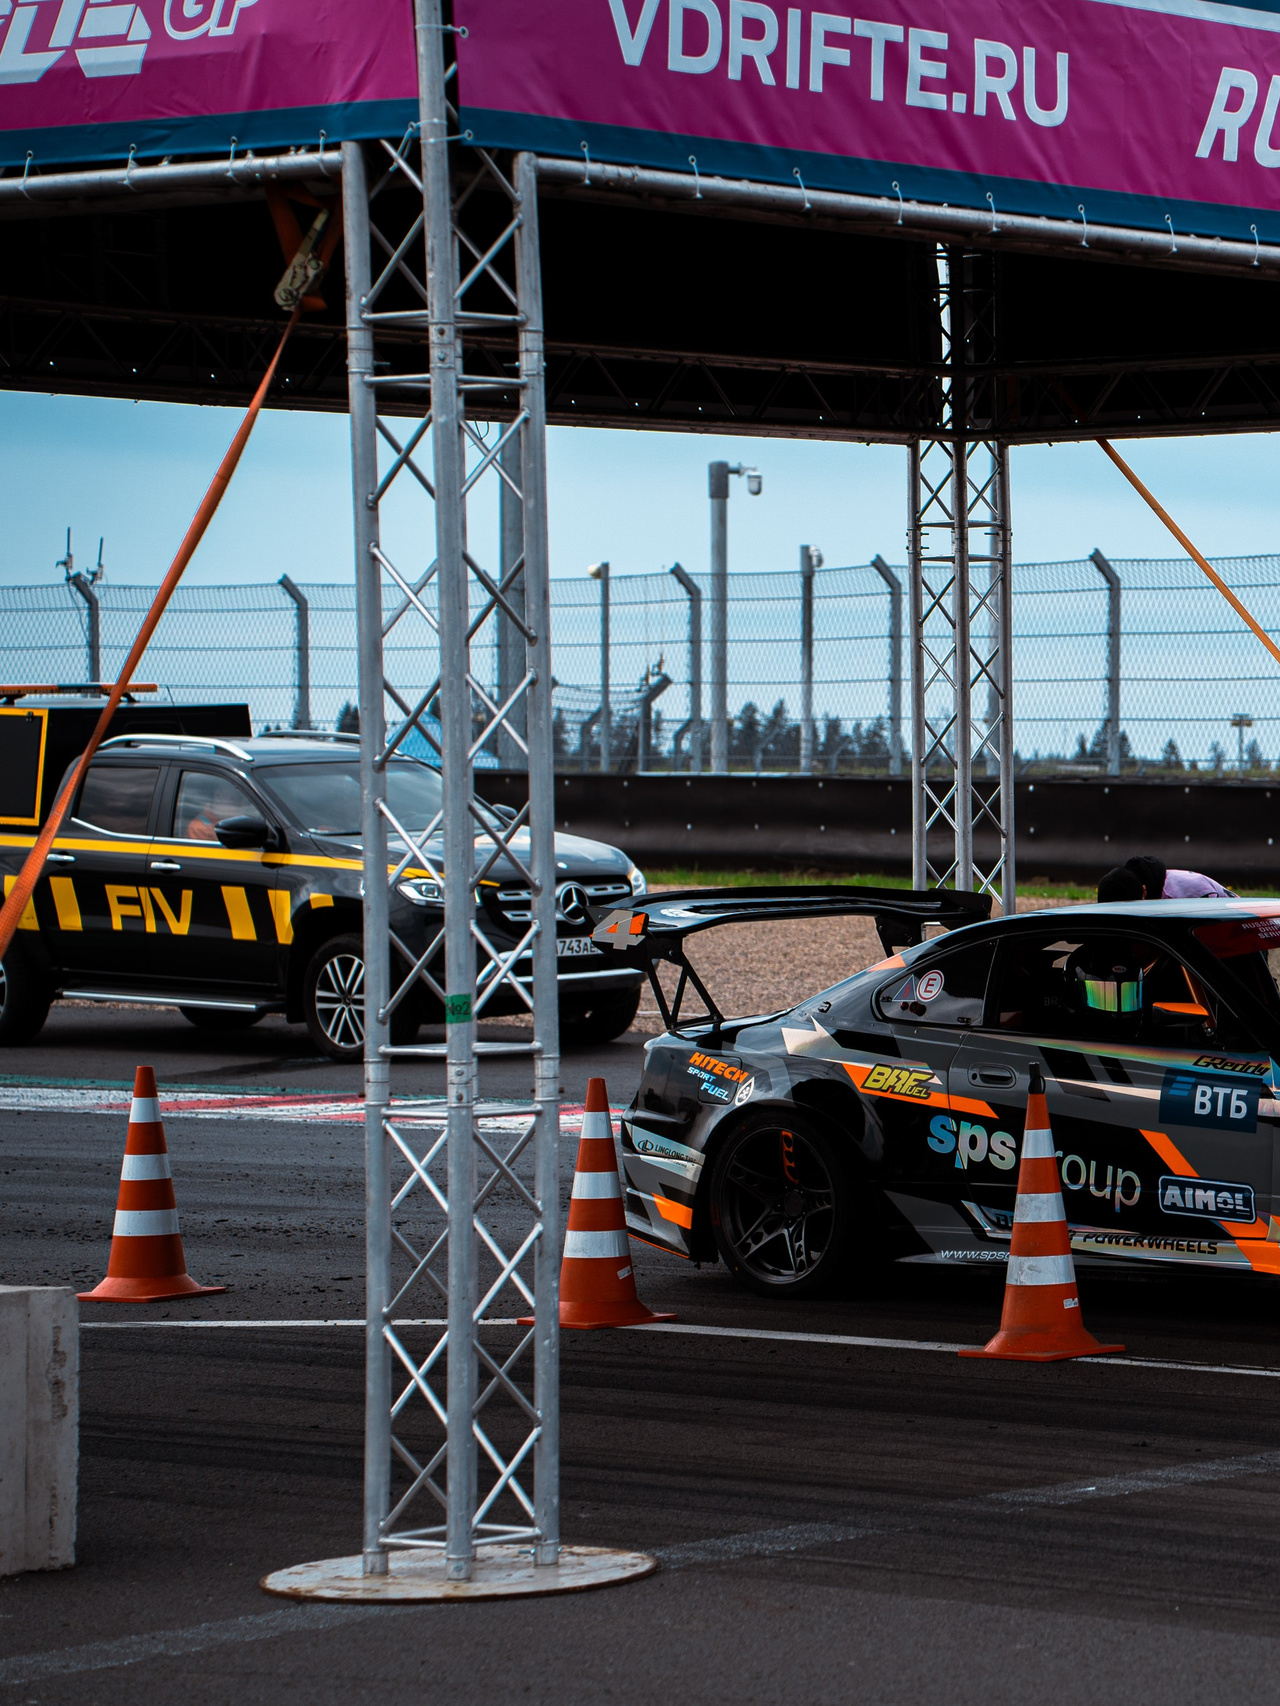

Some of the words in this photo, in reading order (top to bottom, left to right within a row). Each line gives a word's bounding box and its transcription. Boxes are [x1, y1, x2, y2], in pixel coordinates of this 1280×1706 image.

[609, 0, 1068, 127] VDRIFTE.RU
[923, 977, 937, 994] E
[687, 1066, 717, 1082] SPORT
[689, 1051, 749, 1084] HITECH
[700, 1081, 729, 1101] FUEL
[1194, 1084, 1249, 1119] ВТБ
[655, 1144, 685, 1161] LINGLONG
[1163, 1185, 1250, 1215] AIMOL
